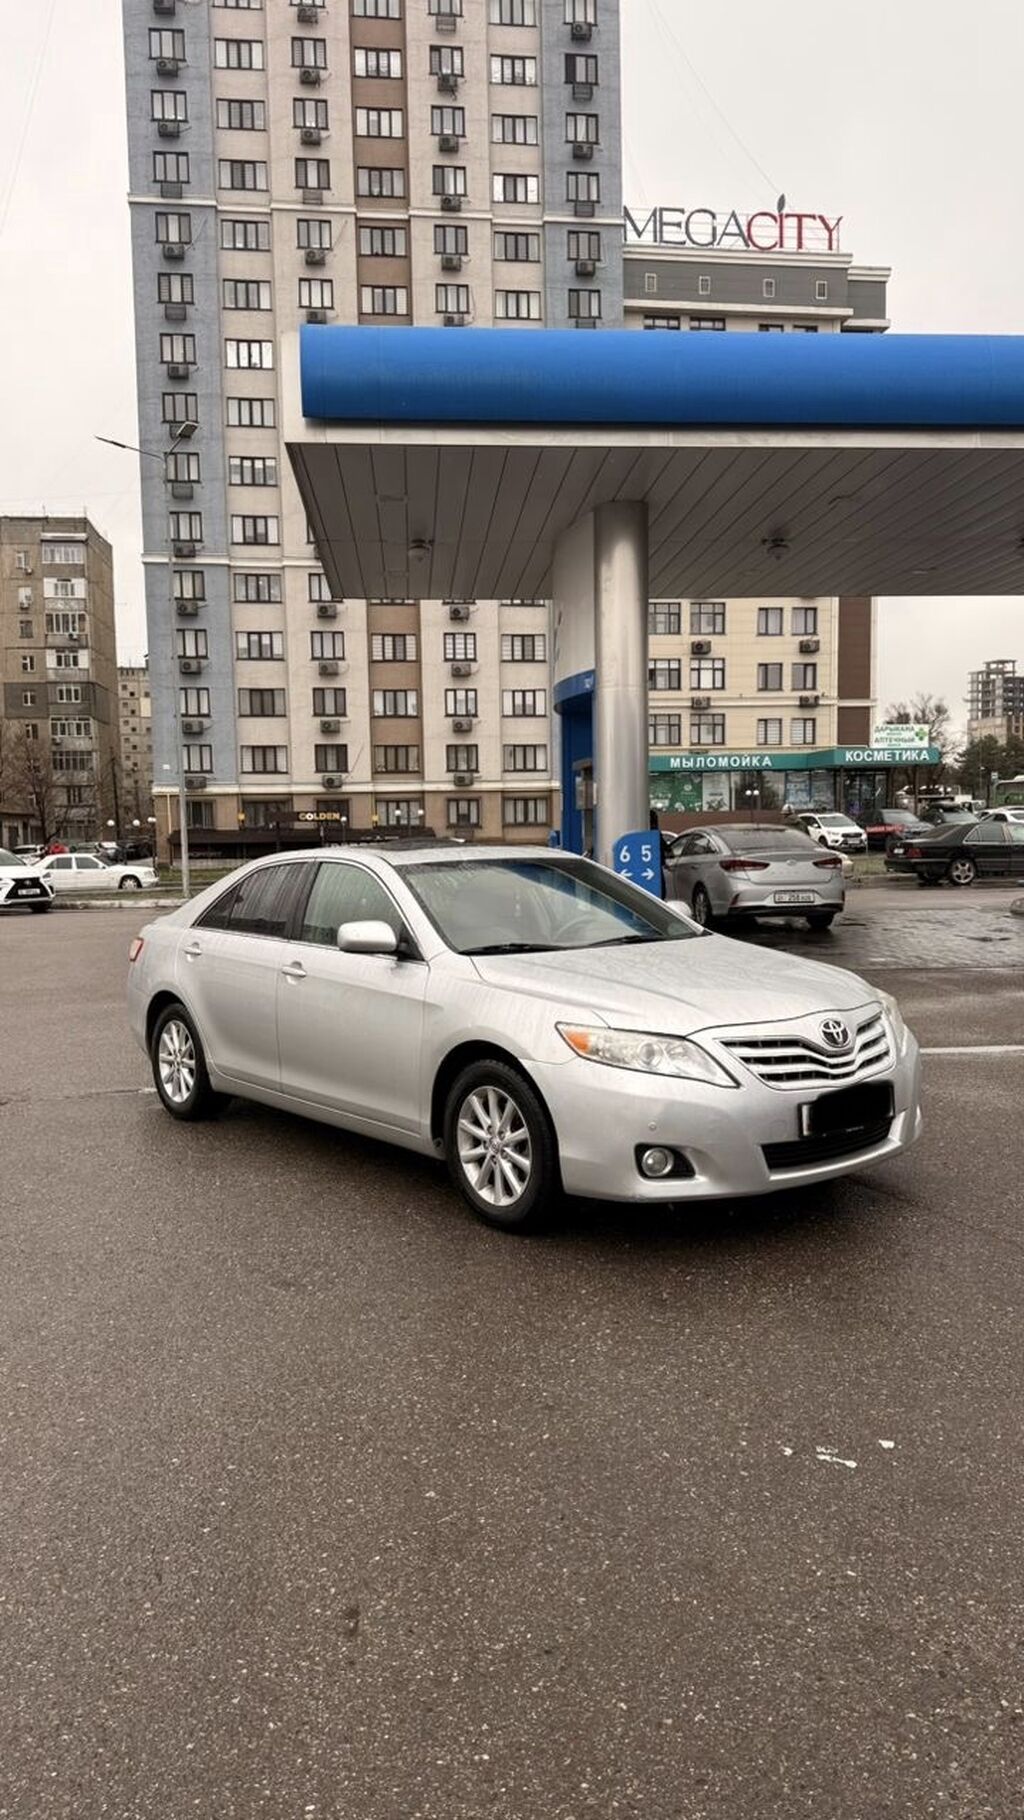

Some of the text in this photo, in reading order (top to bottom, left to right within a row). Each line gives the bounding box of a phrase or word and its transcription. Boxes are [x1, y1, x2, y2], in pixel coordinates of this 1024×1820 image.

[623, 204, 843, 251] MEGACITY
[670, 755, 772, 768] МЫЛОМОЙКА
[845, 750, 930, 762] КОСМЕТИКА
[620, 845, 651, 863] 6 5
